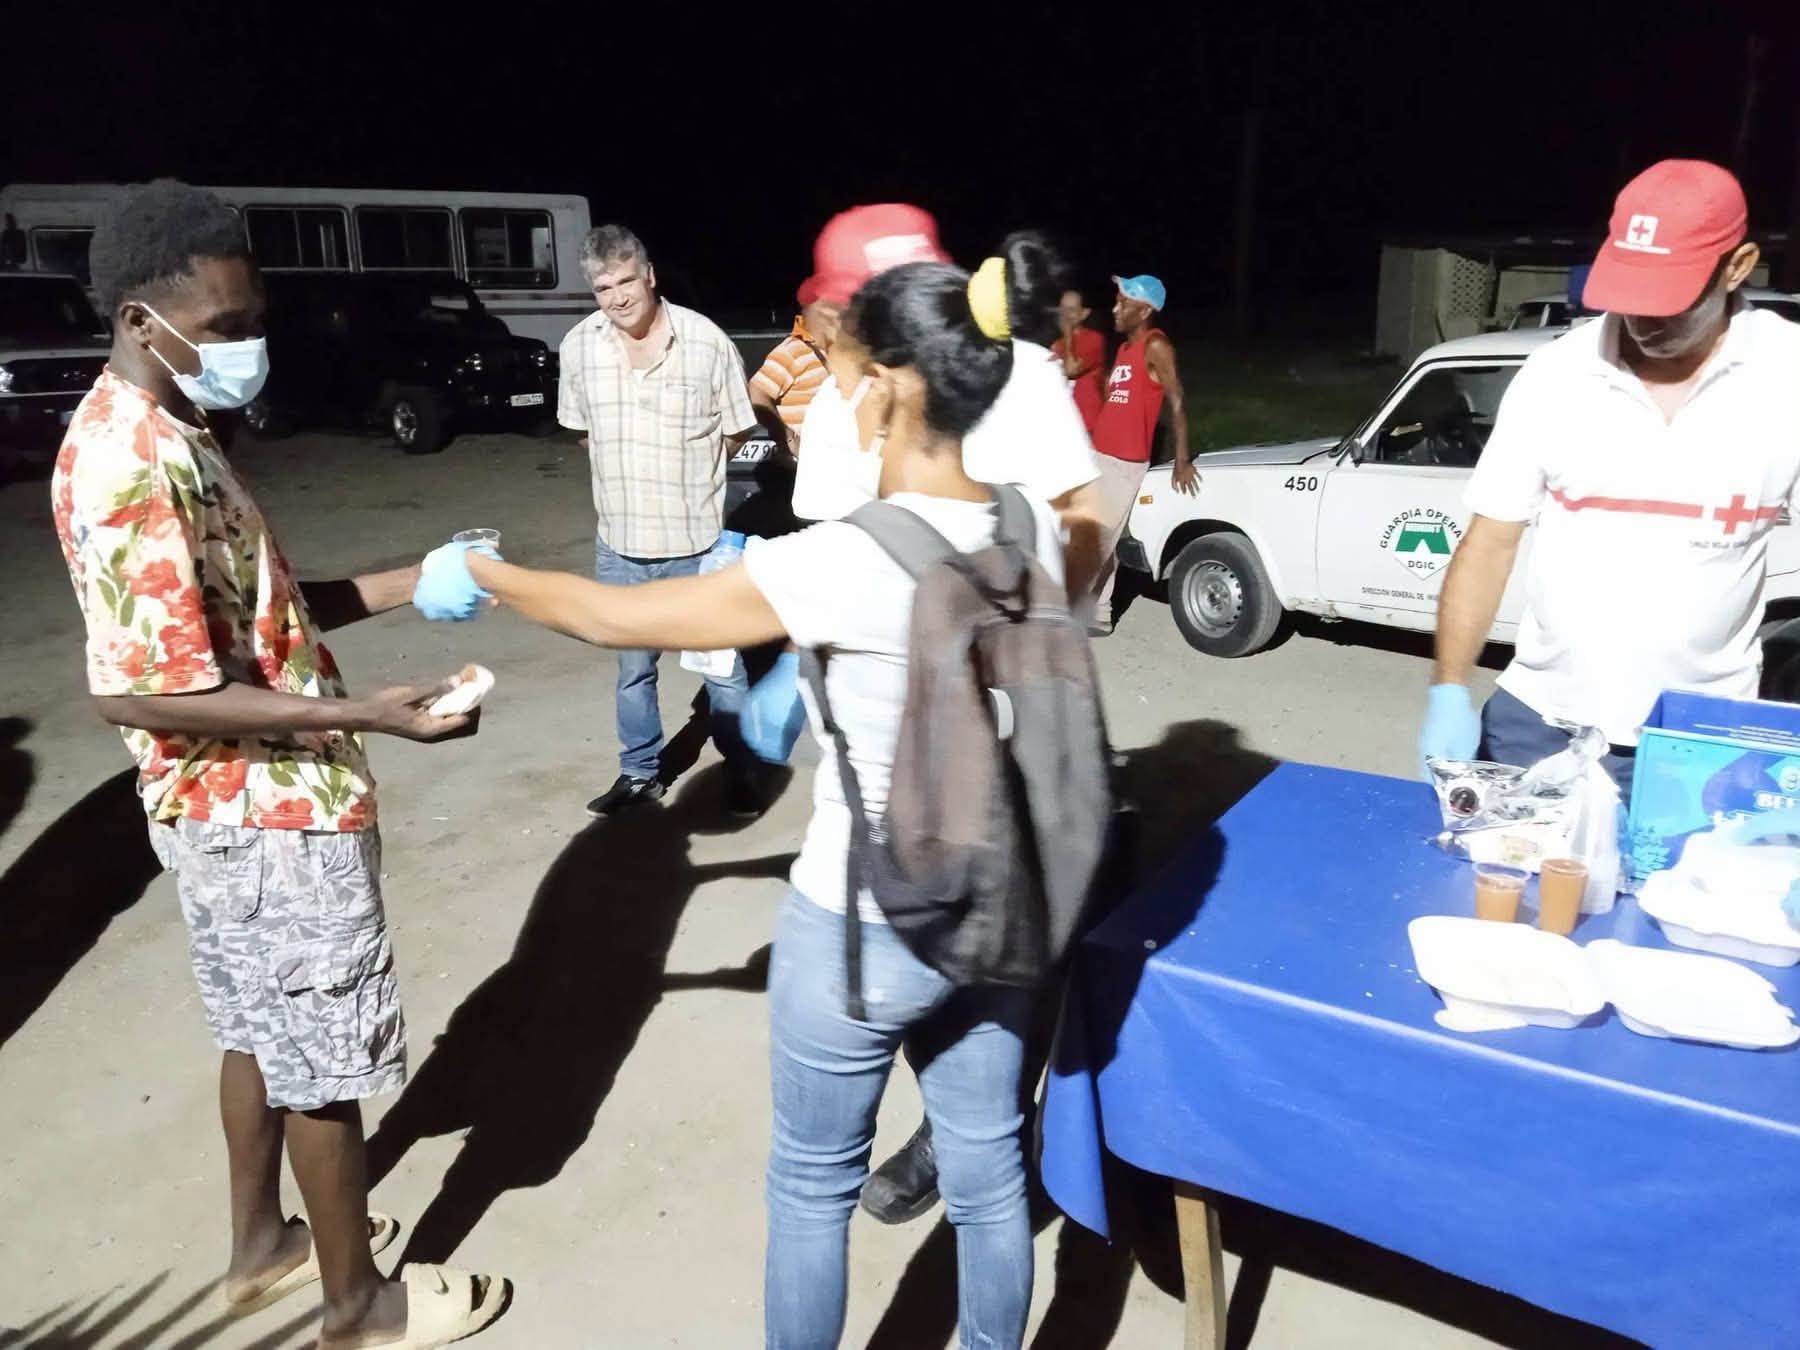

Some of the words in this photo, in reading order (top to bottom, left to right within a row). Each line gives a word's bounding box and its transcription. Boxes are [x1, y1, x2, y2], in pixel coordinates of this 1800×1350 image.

[1284, 476, 1318, 492] 450
[1380, 508, 1421, 549] GUARDIA
[1426, 508, 1463, 541] OPERA
[1408, 560, 1435, 570] DGIC
